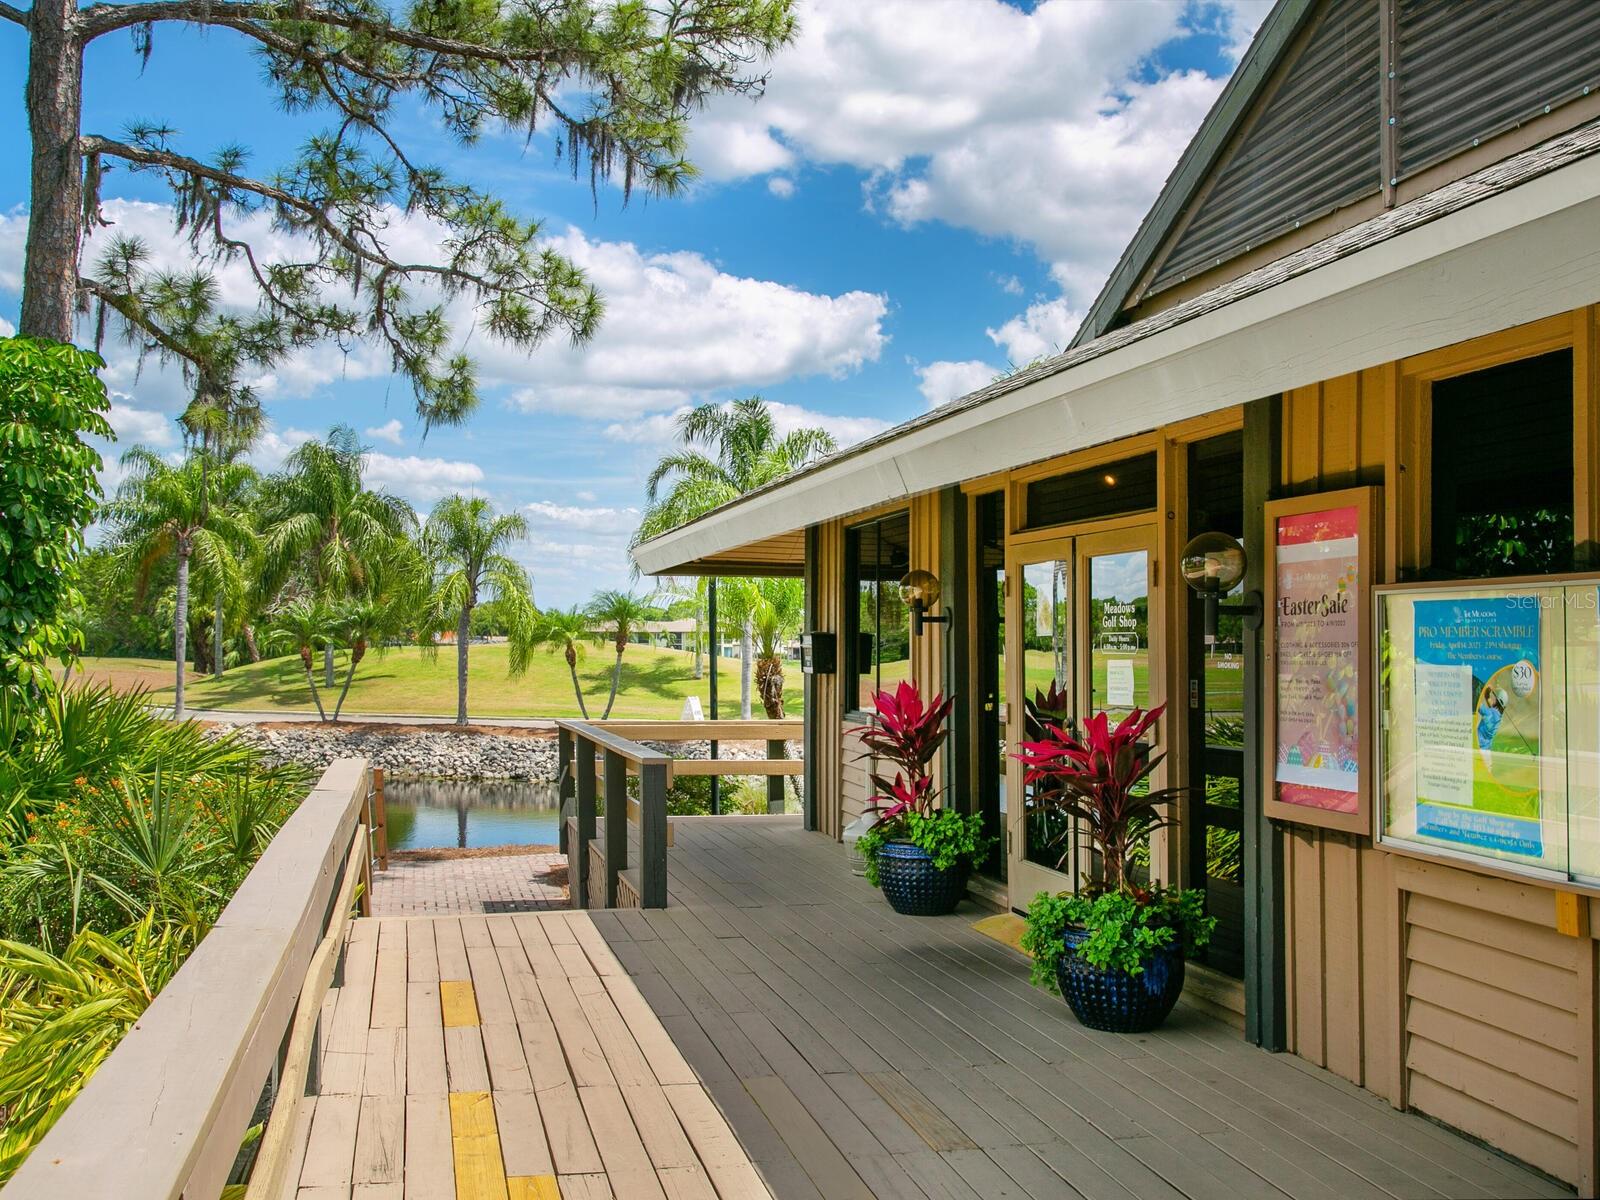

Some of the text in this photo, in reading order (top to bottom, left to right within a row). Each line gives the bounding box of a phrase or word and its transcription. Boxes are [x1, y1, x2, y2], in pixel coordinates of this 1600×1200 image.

[1104, 602, 1136, 614] Meadows
[1102, 616, 1136, 629] Golf Shop
[1418, 625, 1534, 638] PRO MEMBER SCRAMBLE
[1224, 652, 1232, 660] NO
[1217, 661, 1240, 670] SMOKING
[1513, 666, 1531, 680] $30
